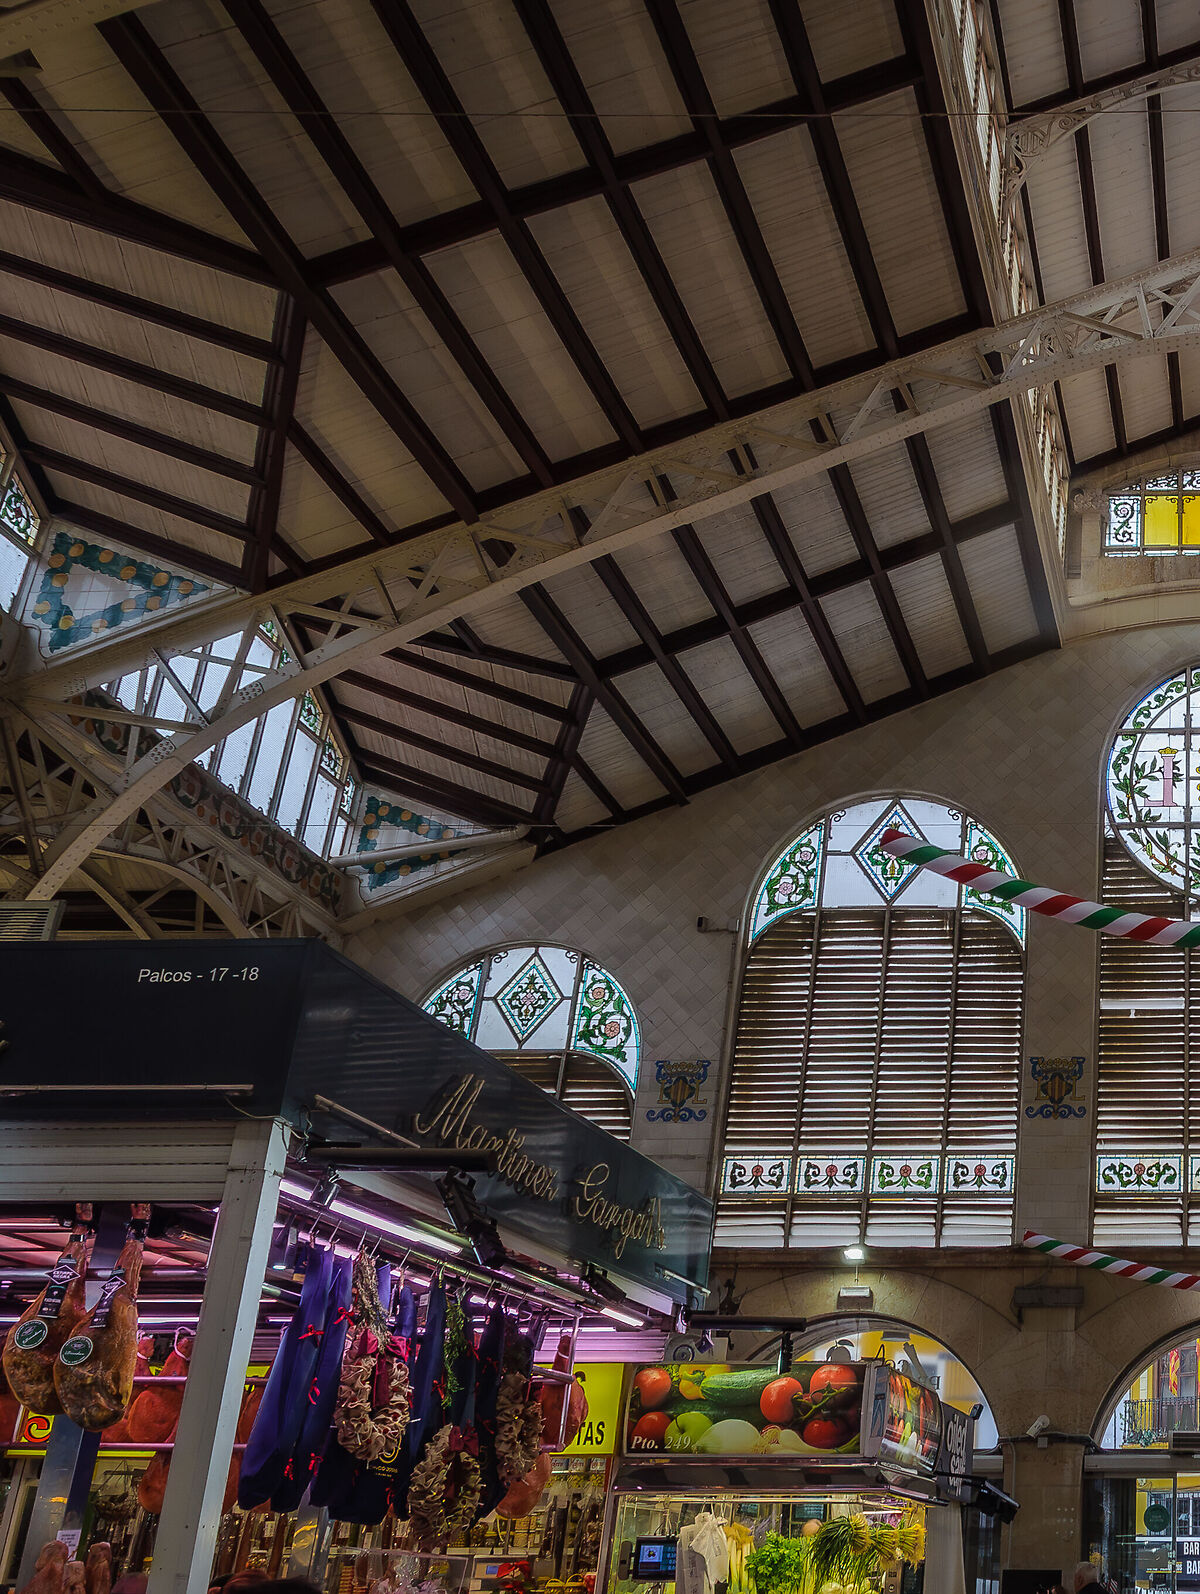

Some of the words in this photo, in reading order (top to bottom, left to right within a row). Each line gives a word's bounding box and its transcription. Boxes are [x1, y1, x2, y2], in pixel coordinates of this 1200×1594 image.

[137, 968, 192, 982] Palcos
[210, 967, 229, 981] 17
[576, 1421, 605, 1446] TAS
[631, 1435, 659, 1450] Pto.
[664, 1435, 691, 1450] 249
[1183, 1542, 1200, 1556] BAR
